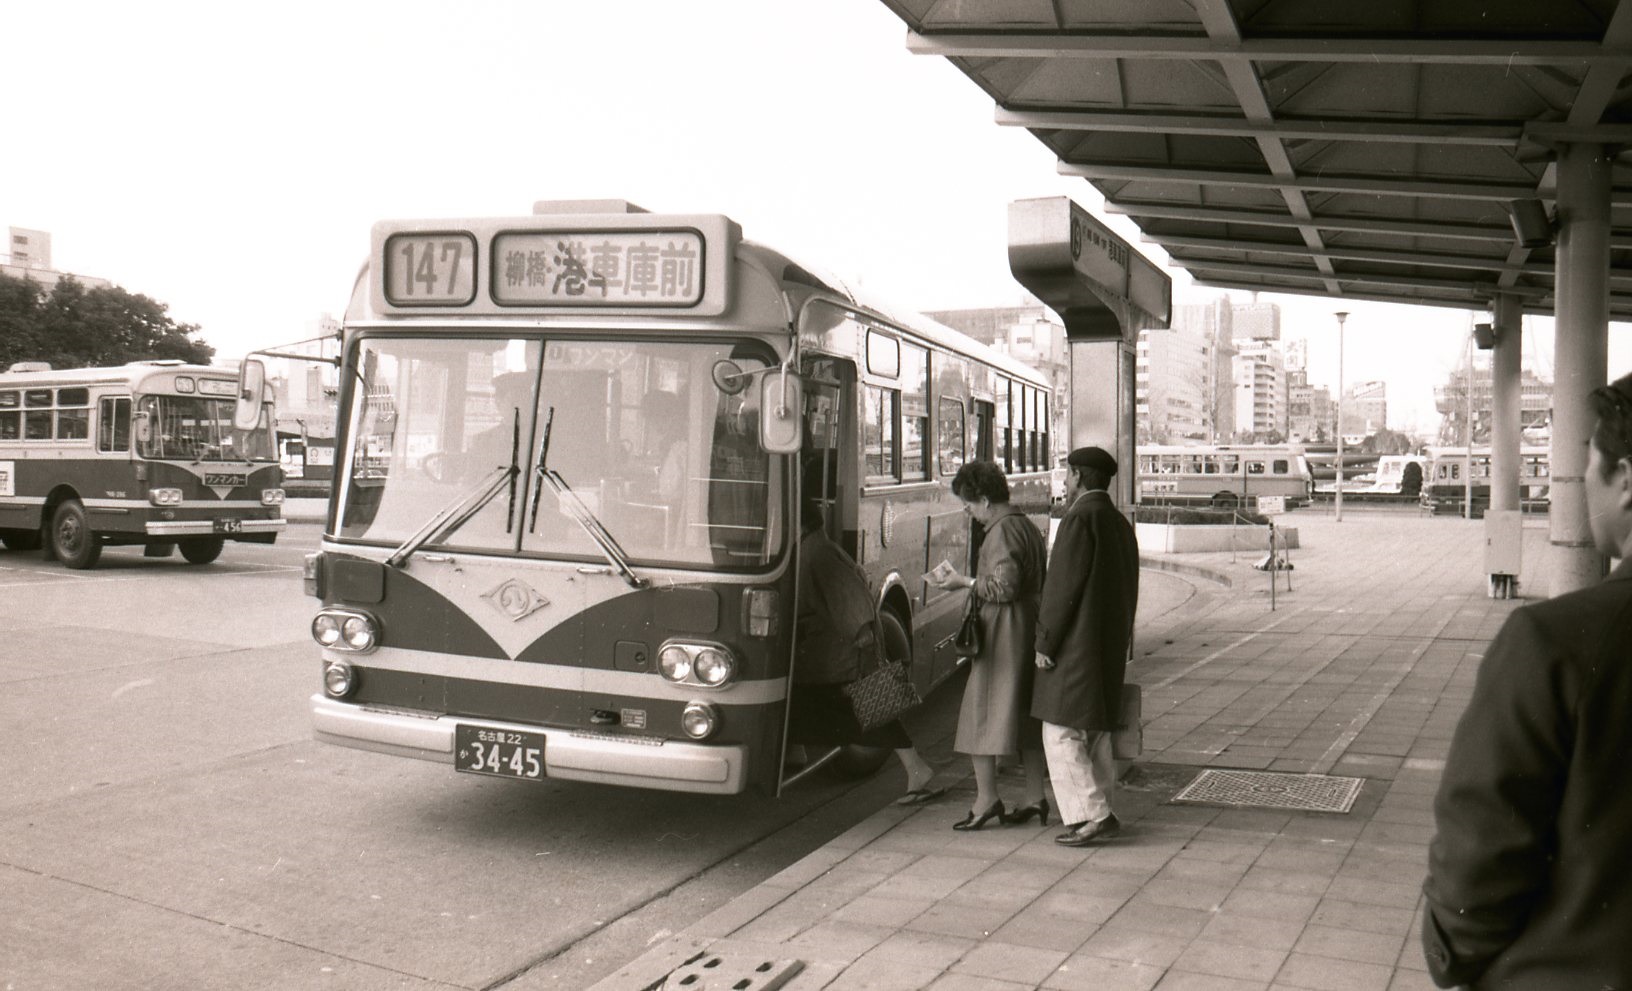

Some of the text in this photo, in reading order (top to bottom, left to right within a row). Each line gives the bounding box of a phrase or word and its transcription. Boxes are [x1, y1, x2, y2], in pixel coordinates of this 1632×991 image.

[401, 241, 463, 295] 147
[205, 474, 246, 484] ワンマンカー
[478, 730, 522, 745] 名古屋 22
[471, 742, 540, 778] 34-45
